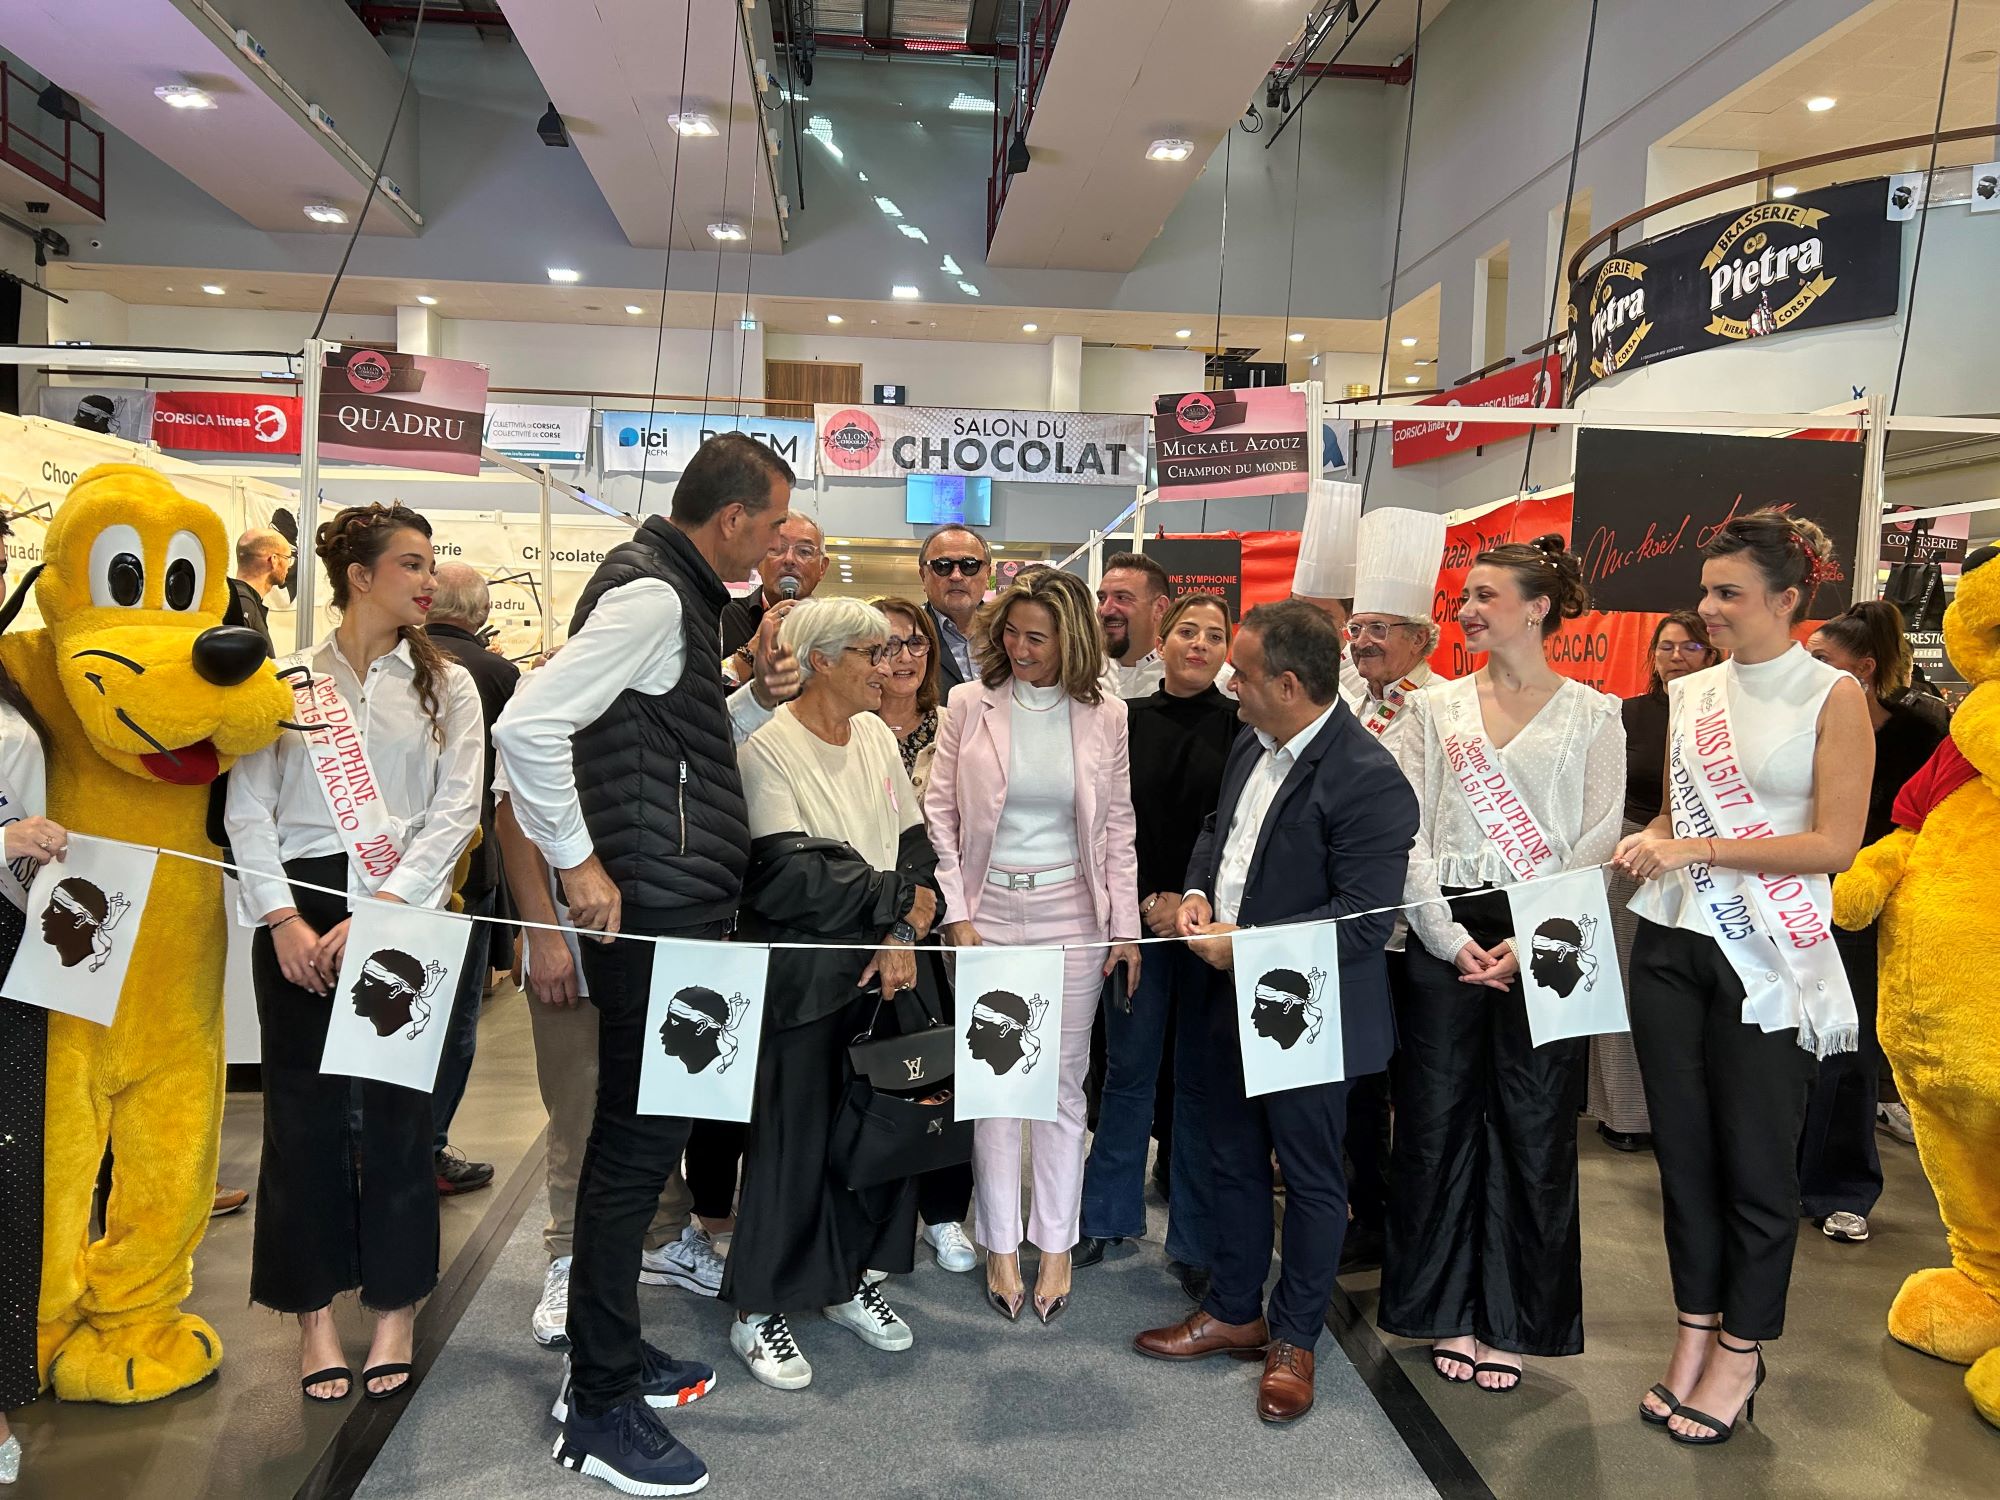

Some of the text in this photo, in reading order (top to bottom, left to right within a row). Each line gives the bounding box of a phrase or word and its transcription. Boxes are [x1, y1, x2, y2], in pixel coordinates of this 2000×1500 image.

[1717, 206, 1800, 251] BRASSERIE
[1709, 237, 1823, 311] Pietra
[1723, 294, 1811, 335] BIERA CORSA
[1617, 339, 1638, 363] CORSA
[154, 410, 251, 427] CORSICA linea
[1508, 391, 1530, 408] linea
[338, 405, 465, 441] QUADRU
[532, 422, 561, 430] CORSICA
[539, 431, 561, 439] CORSE
[640, 427, 668, 448] ici
[837, 432, 867, 440] SALON
[953, 417, 1067, 439] SALON DU
[1394, 424, 1428, 442] CORSICA
[892, 435, 1127, 476] CHOCOLAT
[1167, 461, 1298, 479] CHAMPION DU MONDE
[1177, 585, 1225, 595] D'ARÔMES
[1185, 575, 1237, 584] SYMPHONIE
[314, 675, 378, 806] 1ère DAUPHINE
[1694, 708, 1732, 757] MISS
[1444, 733, 1469, 773] MISS
[1459, 773, 1495, 814] 15/17
[1703, 754, 1754, 809] 15/17
[315, 755, 360, 832] AJACCIO
[1462, 736, 1553, 865] 3ème DAUPHINE
[355, 834, 401, 878] 2025
[1710, 894, 1756, 940] 2025
[1778, 902, 1830, 949] 2025
